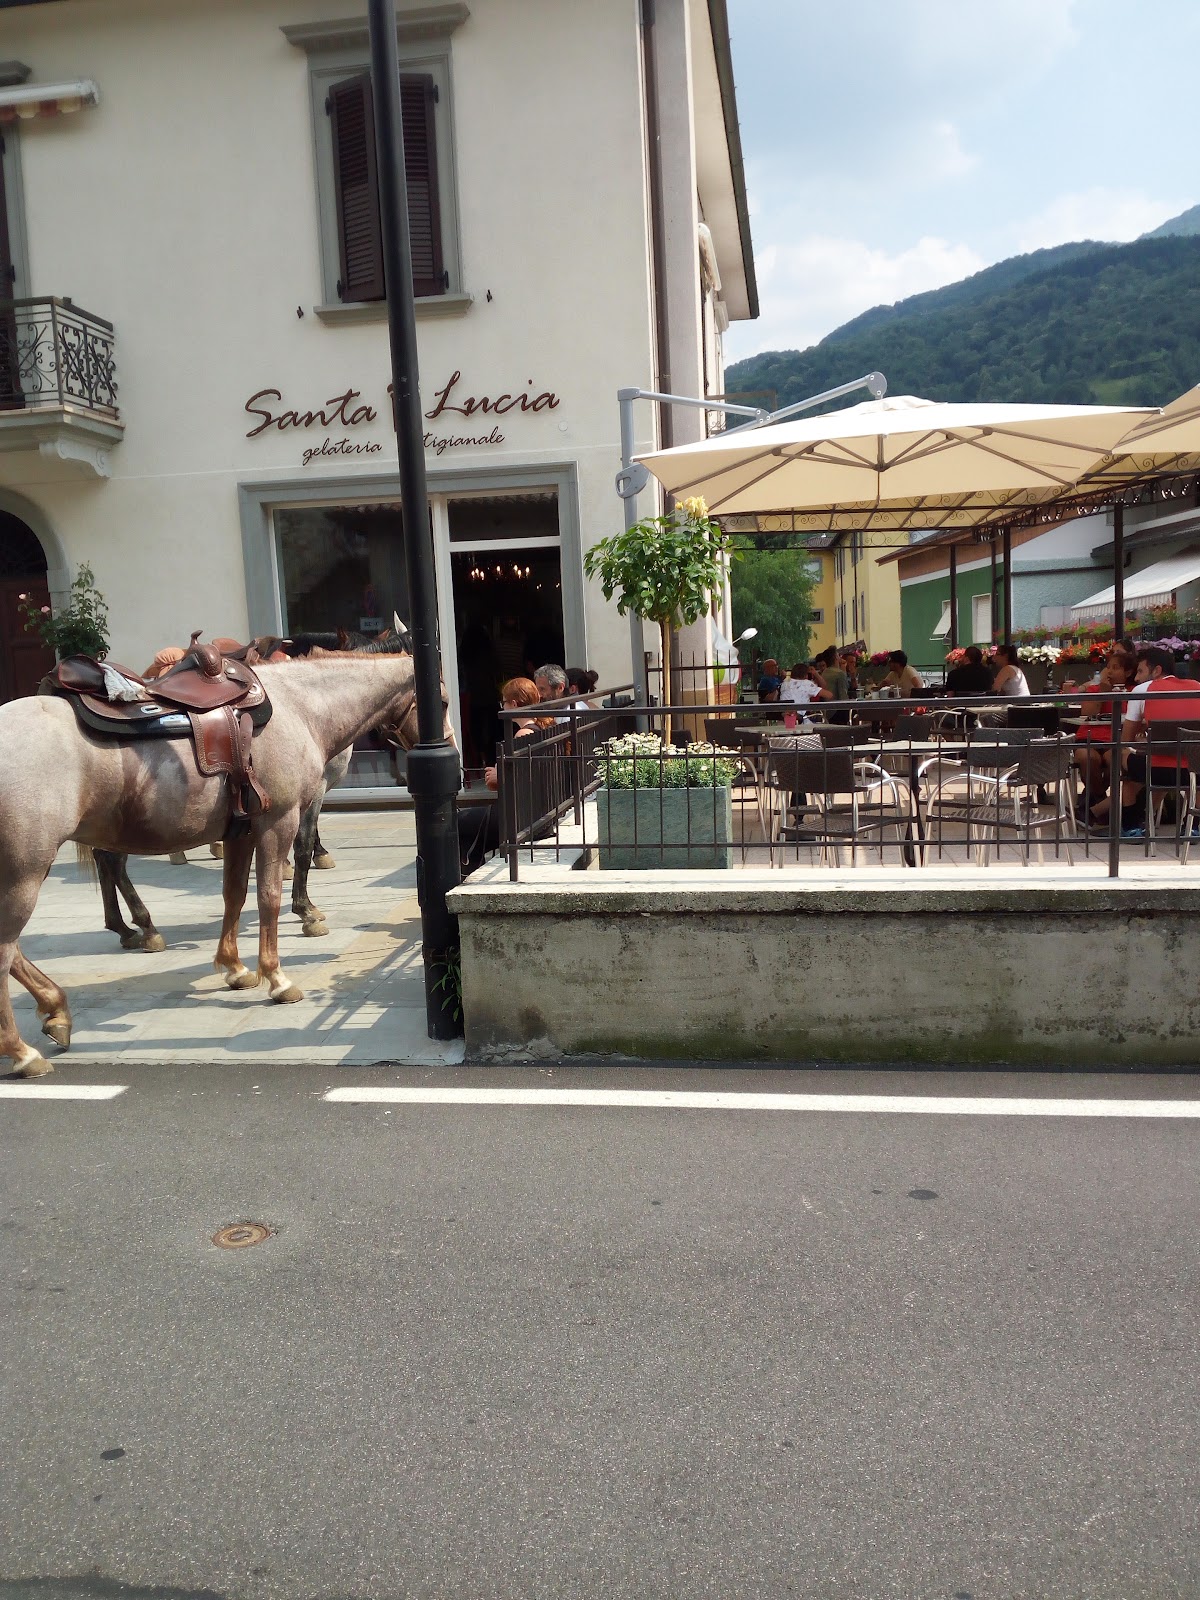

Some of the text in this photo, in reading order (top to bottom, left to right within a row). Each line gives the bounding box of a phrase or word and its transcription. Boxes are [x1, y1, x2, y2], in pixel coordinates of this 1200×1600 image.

[245, 370, 560, 438] Santa Lucia
[302, 426, 505, 466] gelateria tigianale
